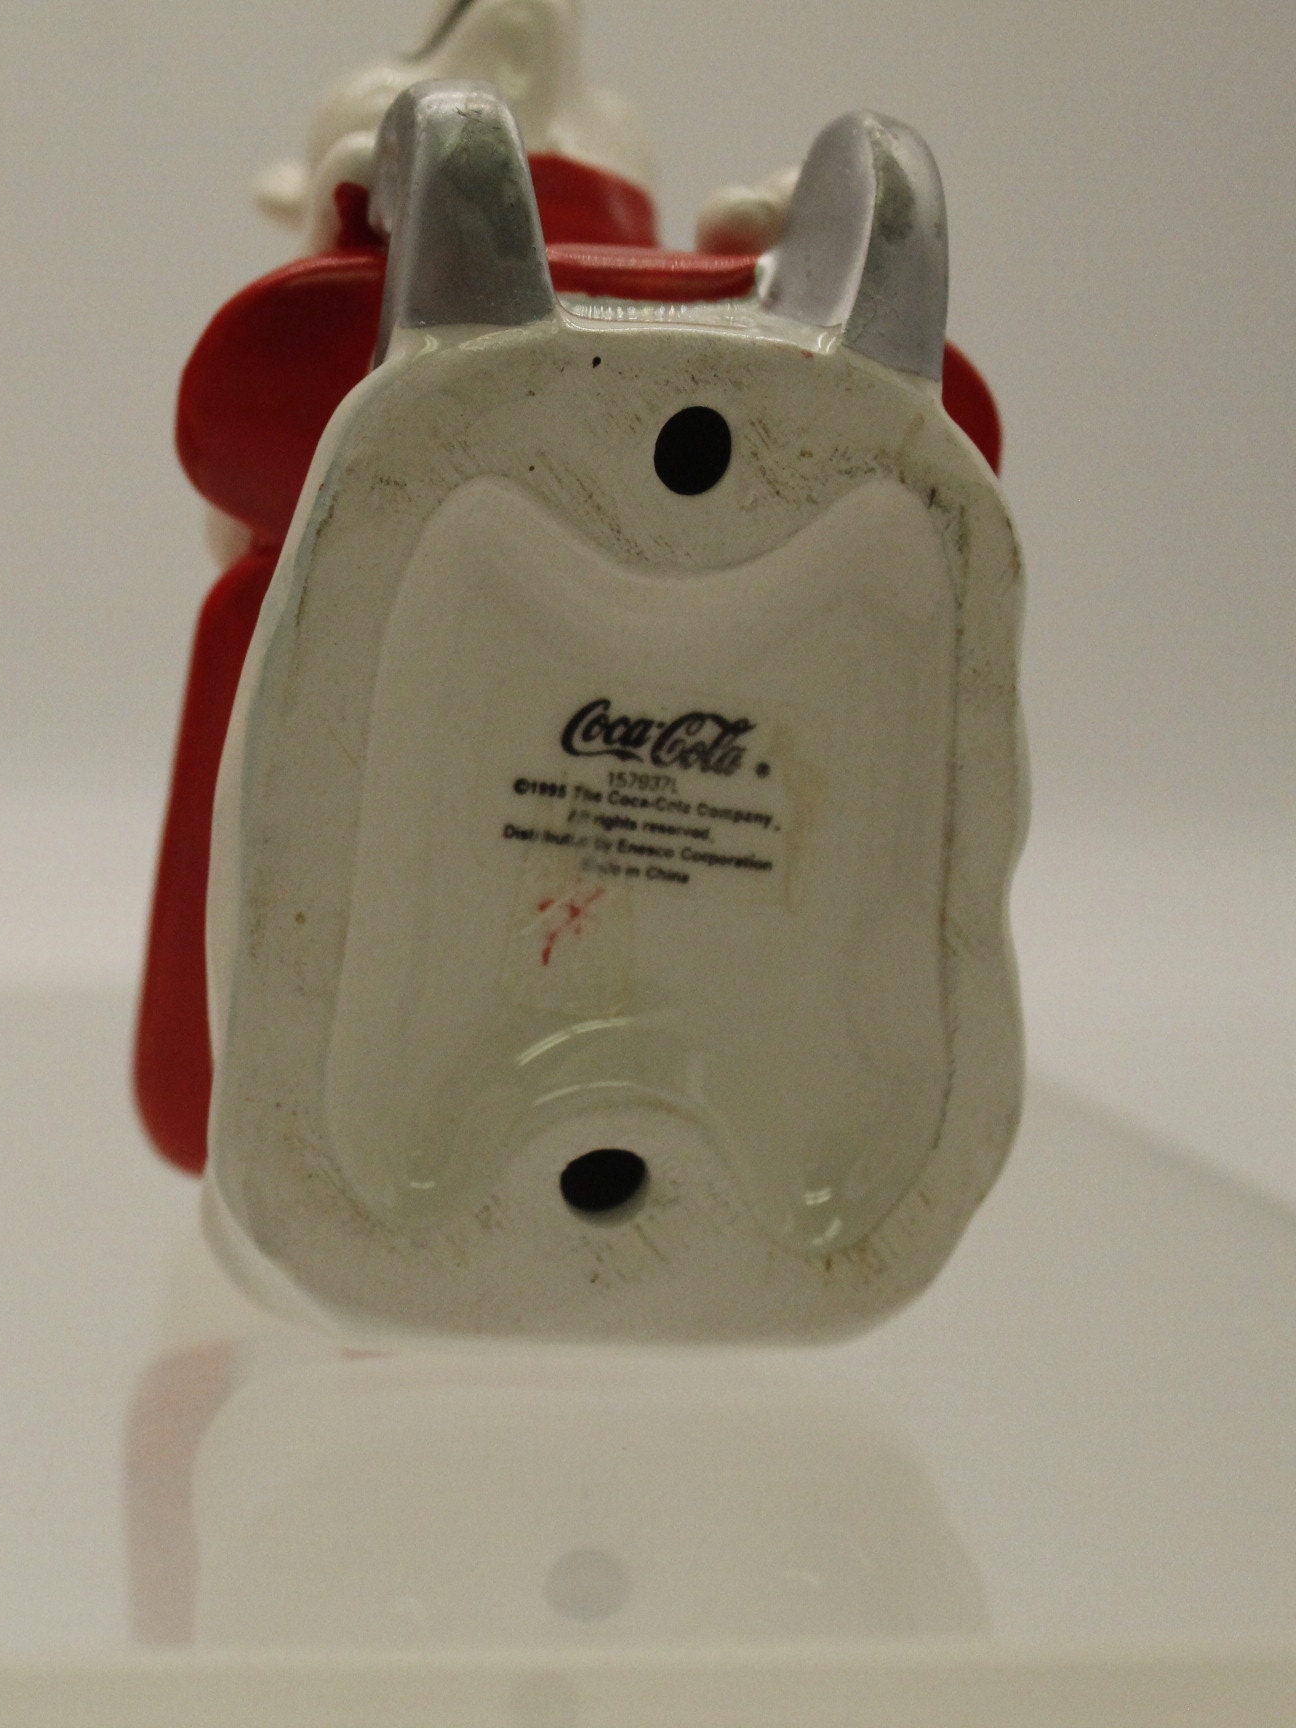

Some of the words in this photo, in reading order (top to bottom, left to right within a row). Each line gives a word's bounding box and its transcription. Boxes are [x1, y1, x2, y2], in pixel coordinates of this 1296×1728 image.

[561, 698, 757, 776] Coca-Cola
[574, 785, 603, 803] The
[608, 790, 691, 815] Coca-Cola
[594, 813, 638, 831] rights
[594, 836, 614, 853] by
[617, 838, 675, 859] Enesco
[680, 846, 773, 870] Corporation
[645, 865, 690, 884] China
